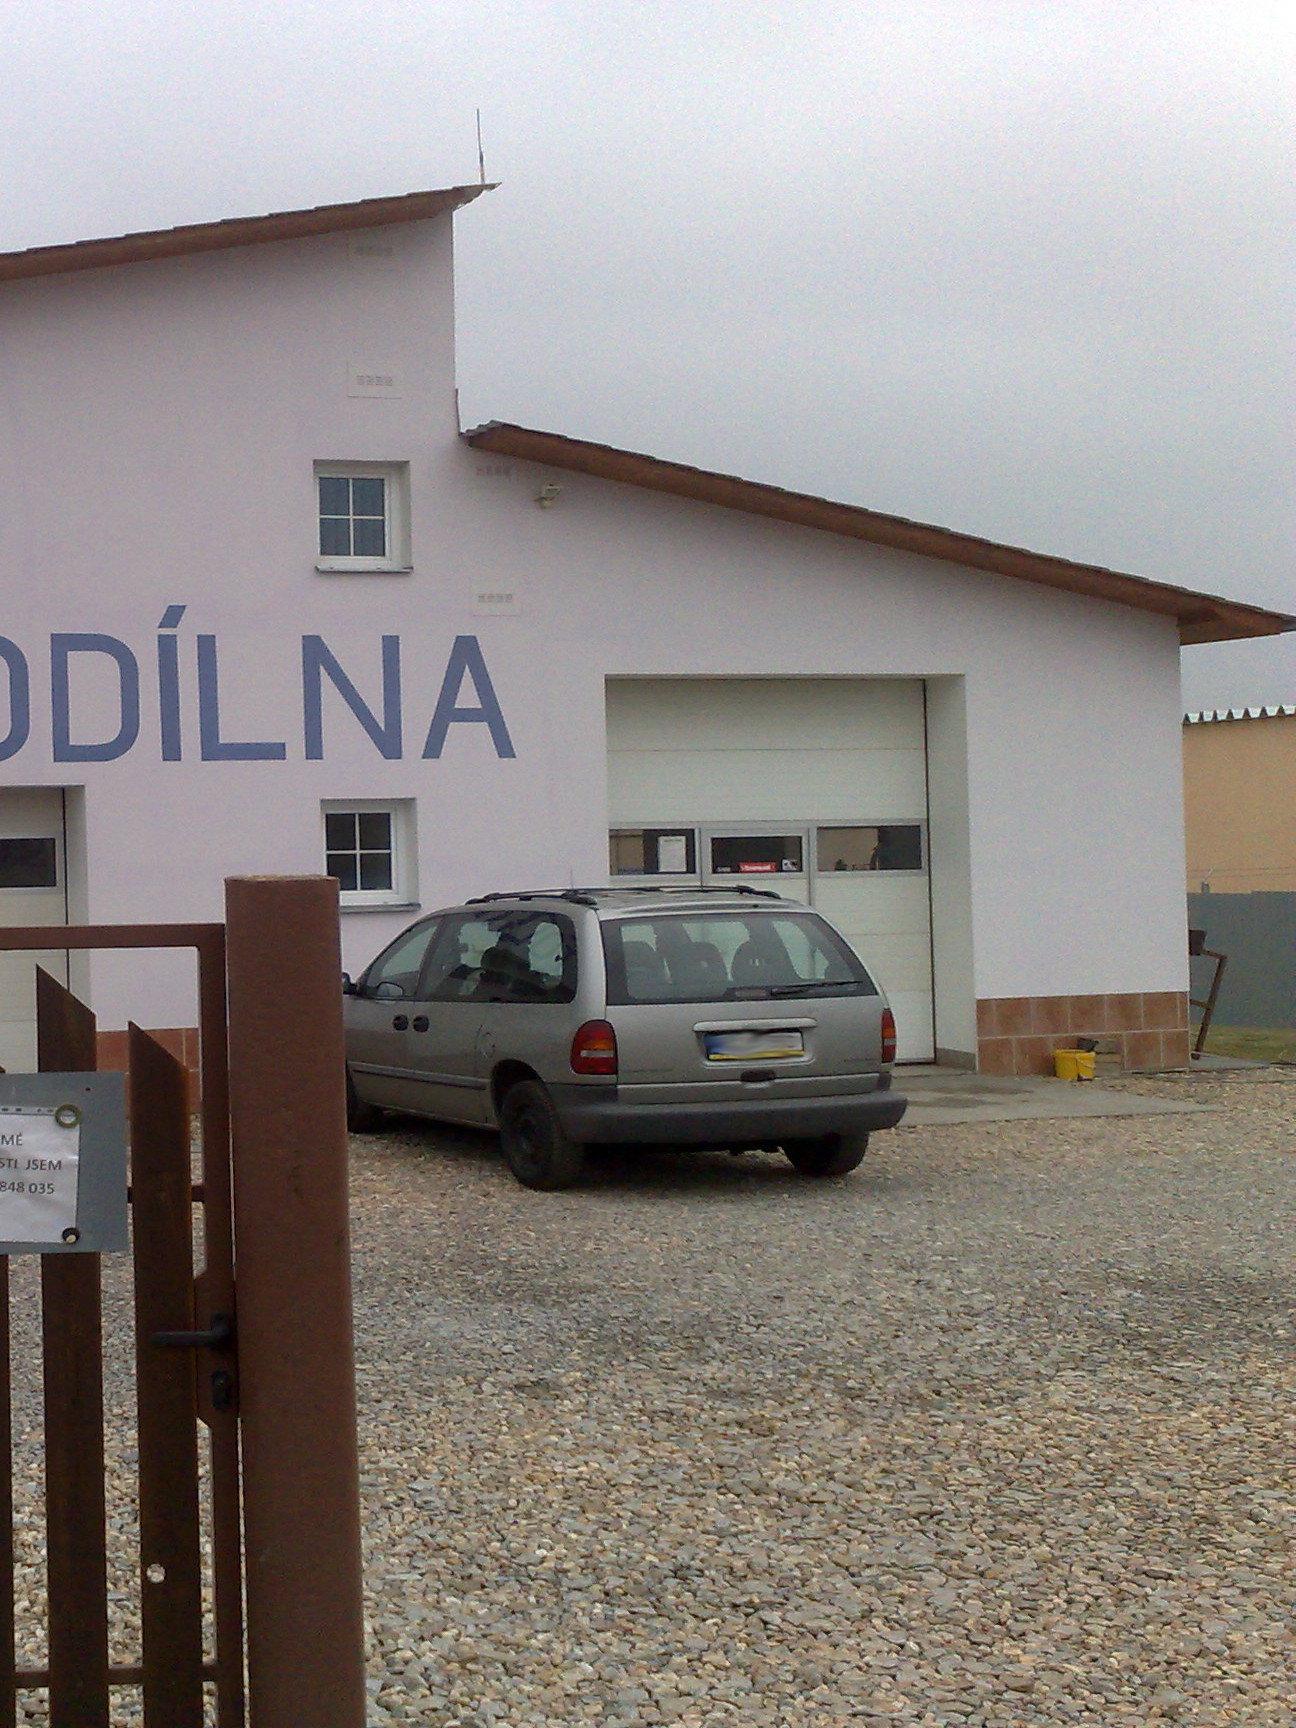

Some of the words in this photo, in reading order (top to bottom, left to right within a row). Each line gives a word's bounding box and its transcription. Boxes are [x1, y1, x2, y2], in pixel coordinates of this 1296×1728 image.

[0, 1132, 23, 1147] MÉ
[25, 1158, 62, 1171] JSEM
[28, 1182, 55, 1195] 035
